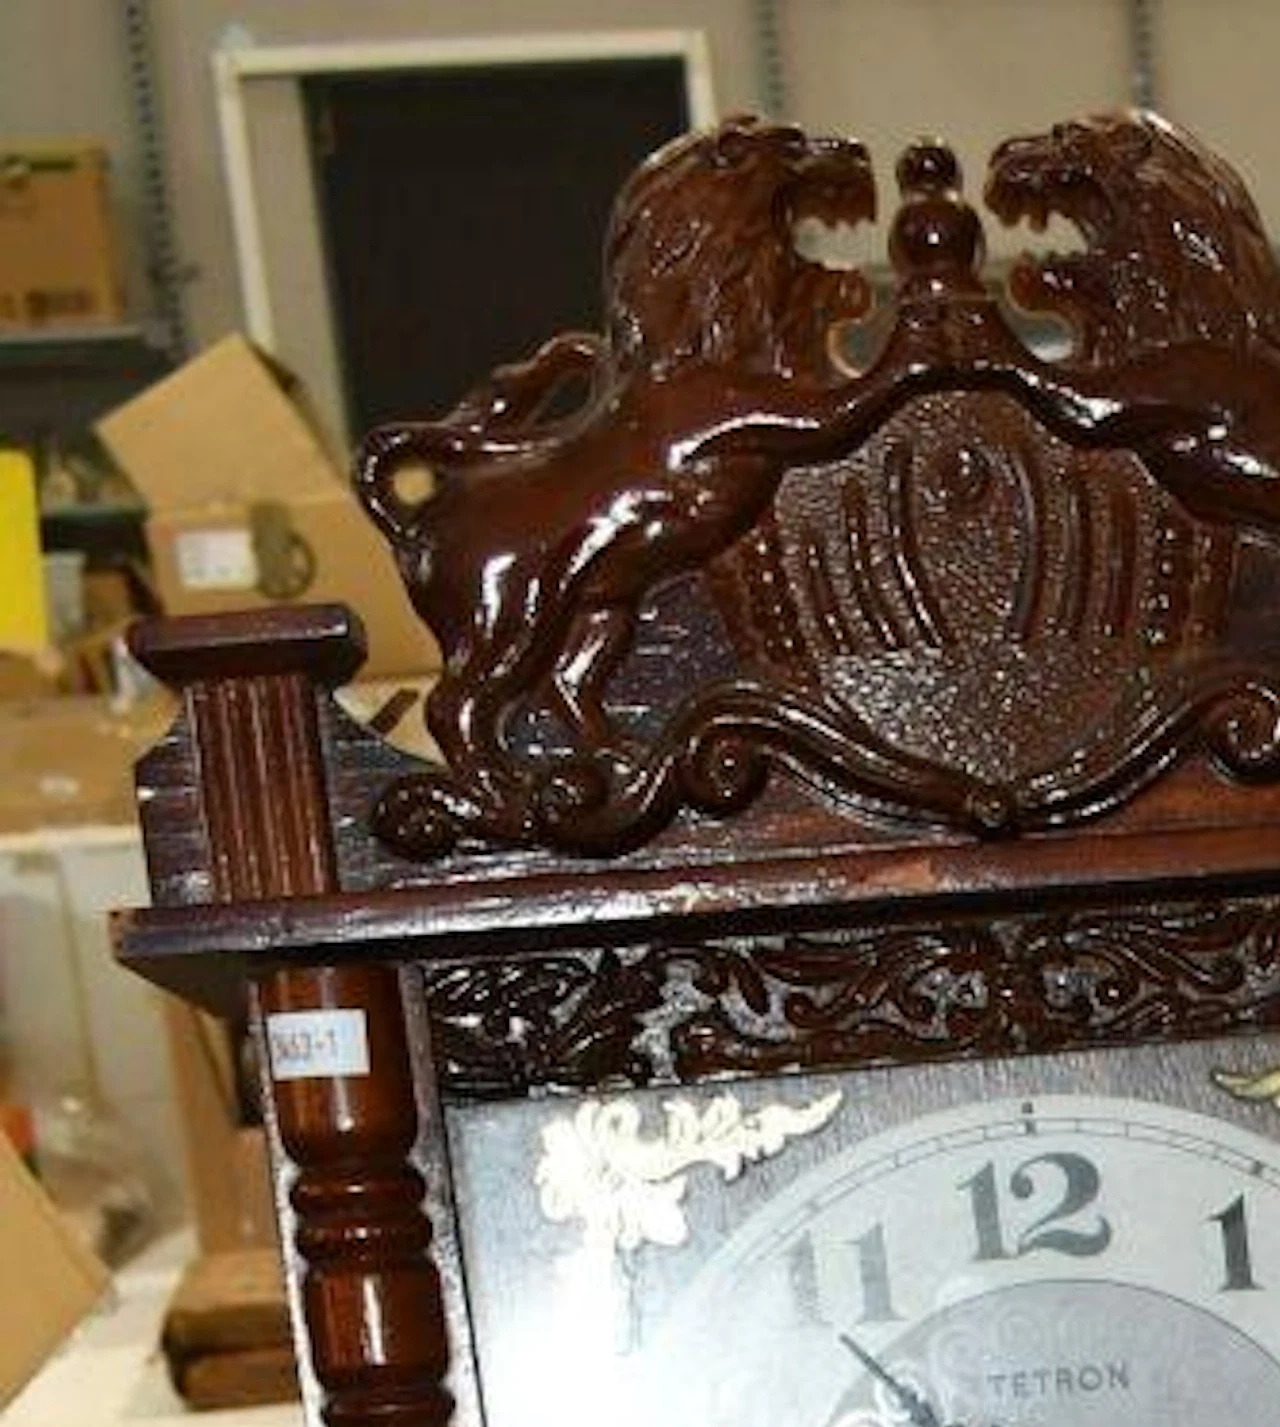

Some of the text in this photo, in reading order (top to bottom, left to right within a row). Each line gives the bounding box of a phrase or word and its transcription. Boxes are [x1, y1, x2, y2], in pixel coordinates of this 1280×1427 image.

[957, 1151, 1113, 1261] 12
[1208, 1193, 1266, 1291] 1
[785, 1221, 906, 1325] 11
[986, 1362, 1130, 1398] TETRON
